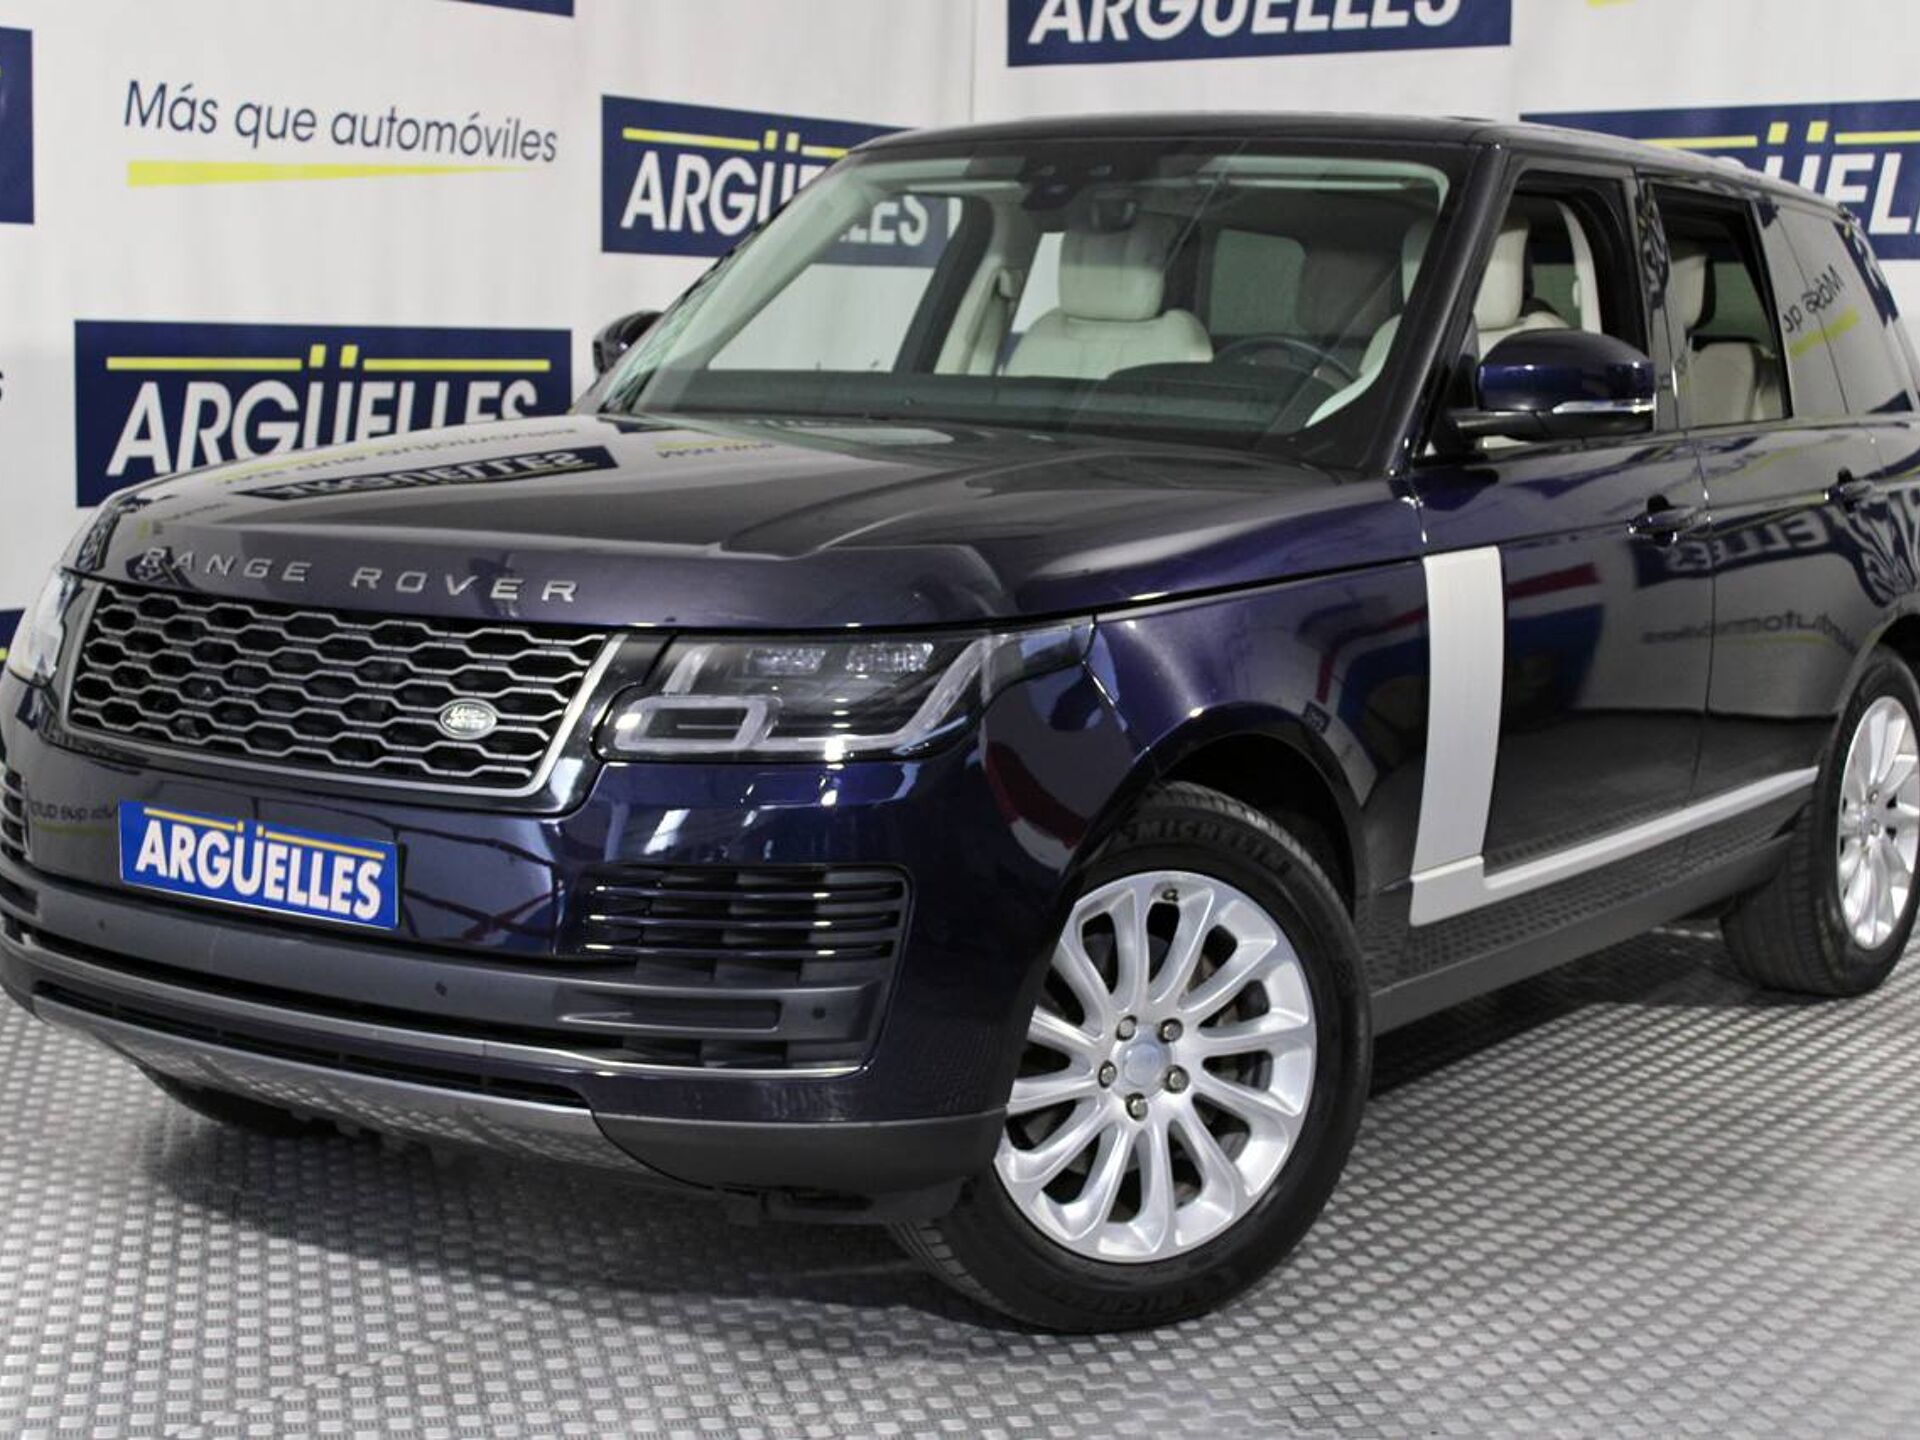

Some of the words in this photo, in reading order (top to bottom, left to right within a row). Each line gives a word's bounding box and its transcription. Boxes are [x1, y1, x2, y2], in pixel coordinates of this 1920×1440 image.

[123, 80, 218, 133] Más
[234, 101, 318, 148] que
[331, 105, 557, 163] automóviles
[141, 547, 312, 582] RANGE
[349, 566, 580, 602] ROVER
[135, 819, 382, 920] ARGÜELLES
